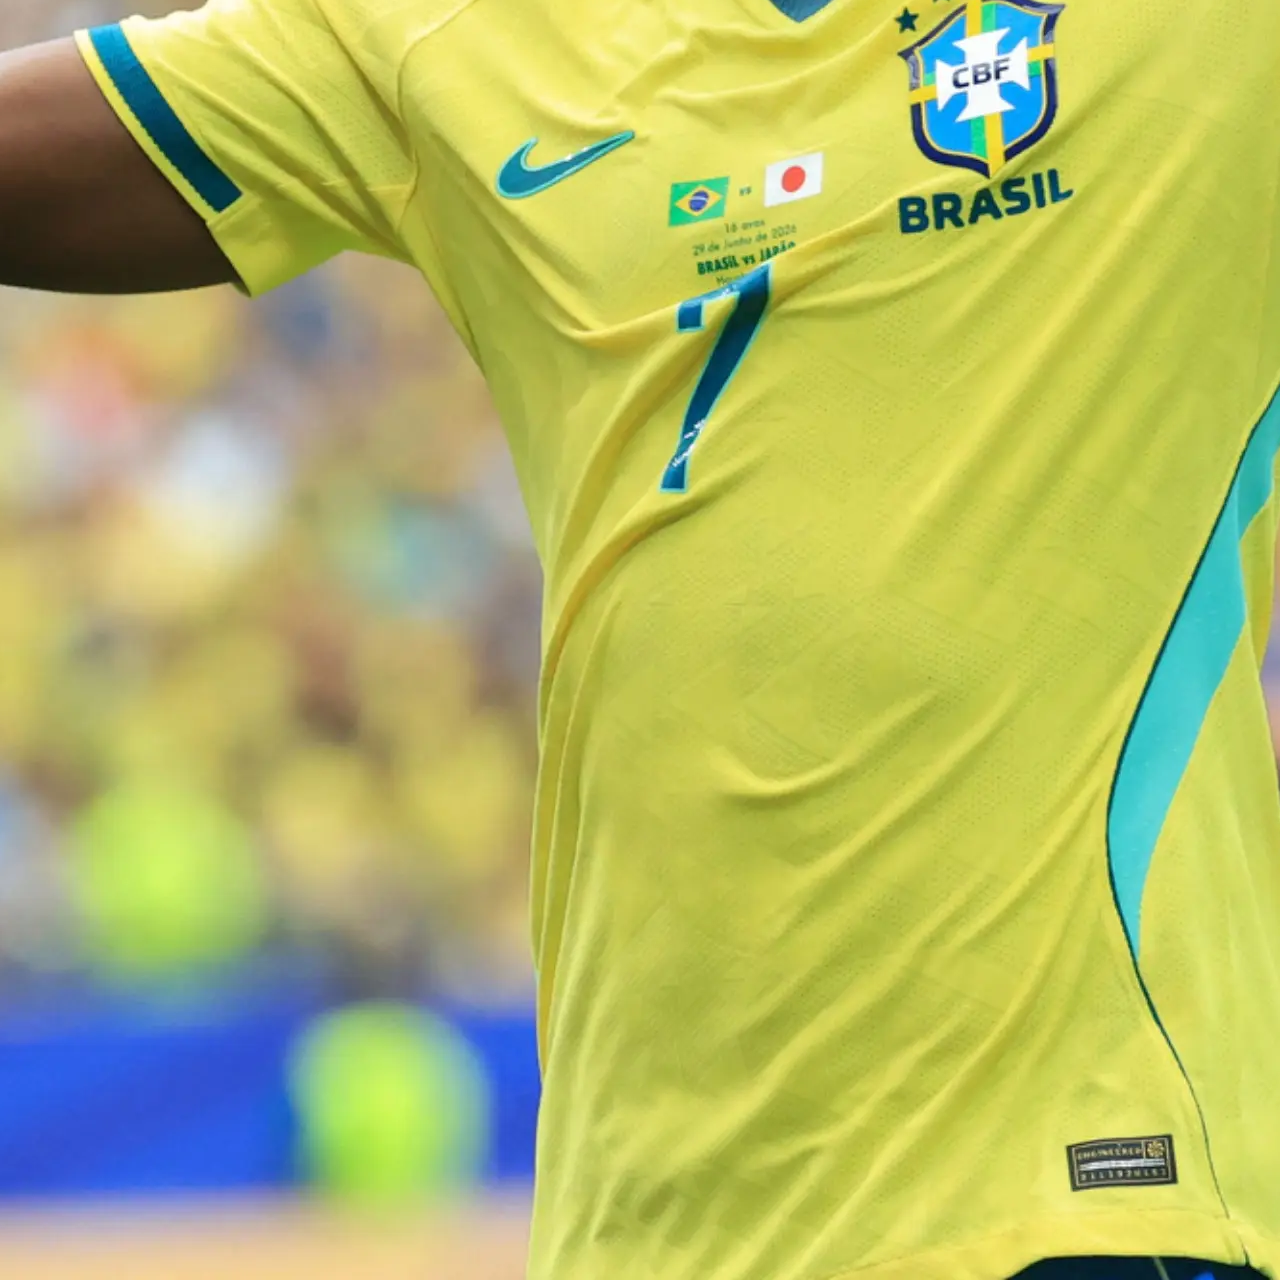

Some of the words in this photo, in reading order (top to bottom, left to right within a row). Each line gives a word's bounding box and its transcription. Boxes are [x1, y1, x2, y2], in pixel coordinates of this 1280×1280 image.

[952, 57, 1010, 89] CBF
[897, 167, 1075, 235] BRASIL
[658, 258, 774, 494] 7
